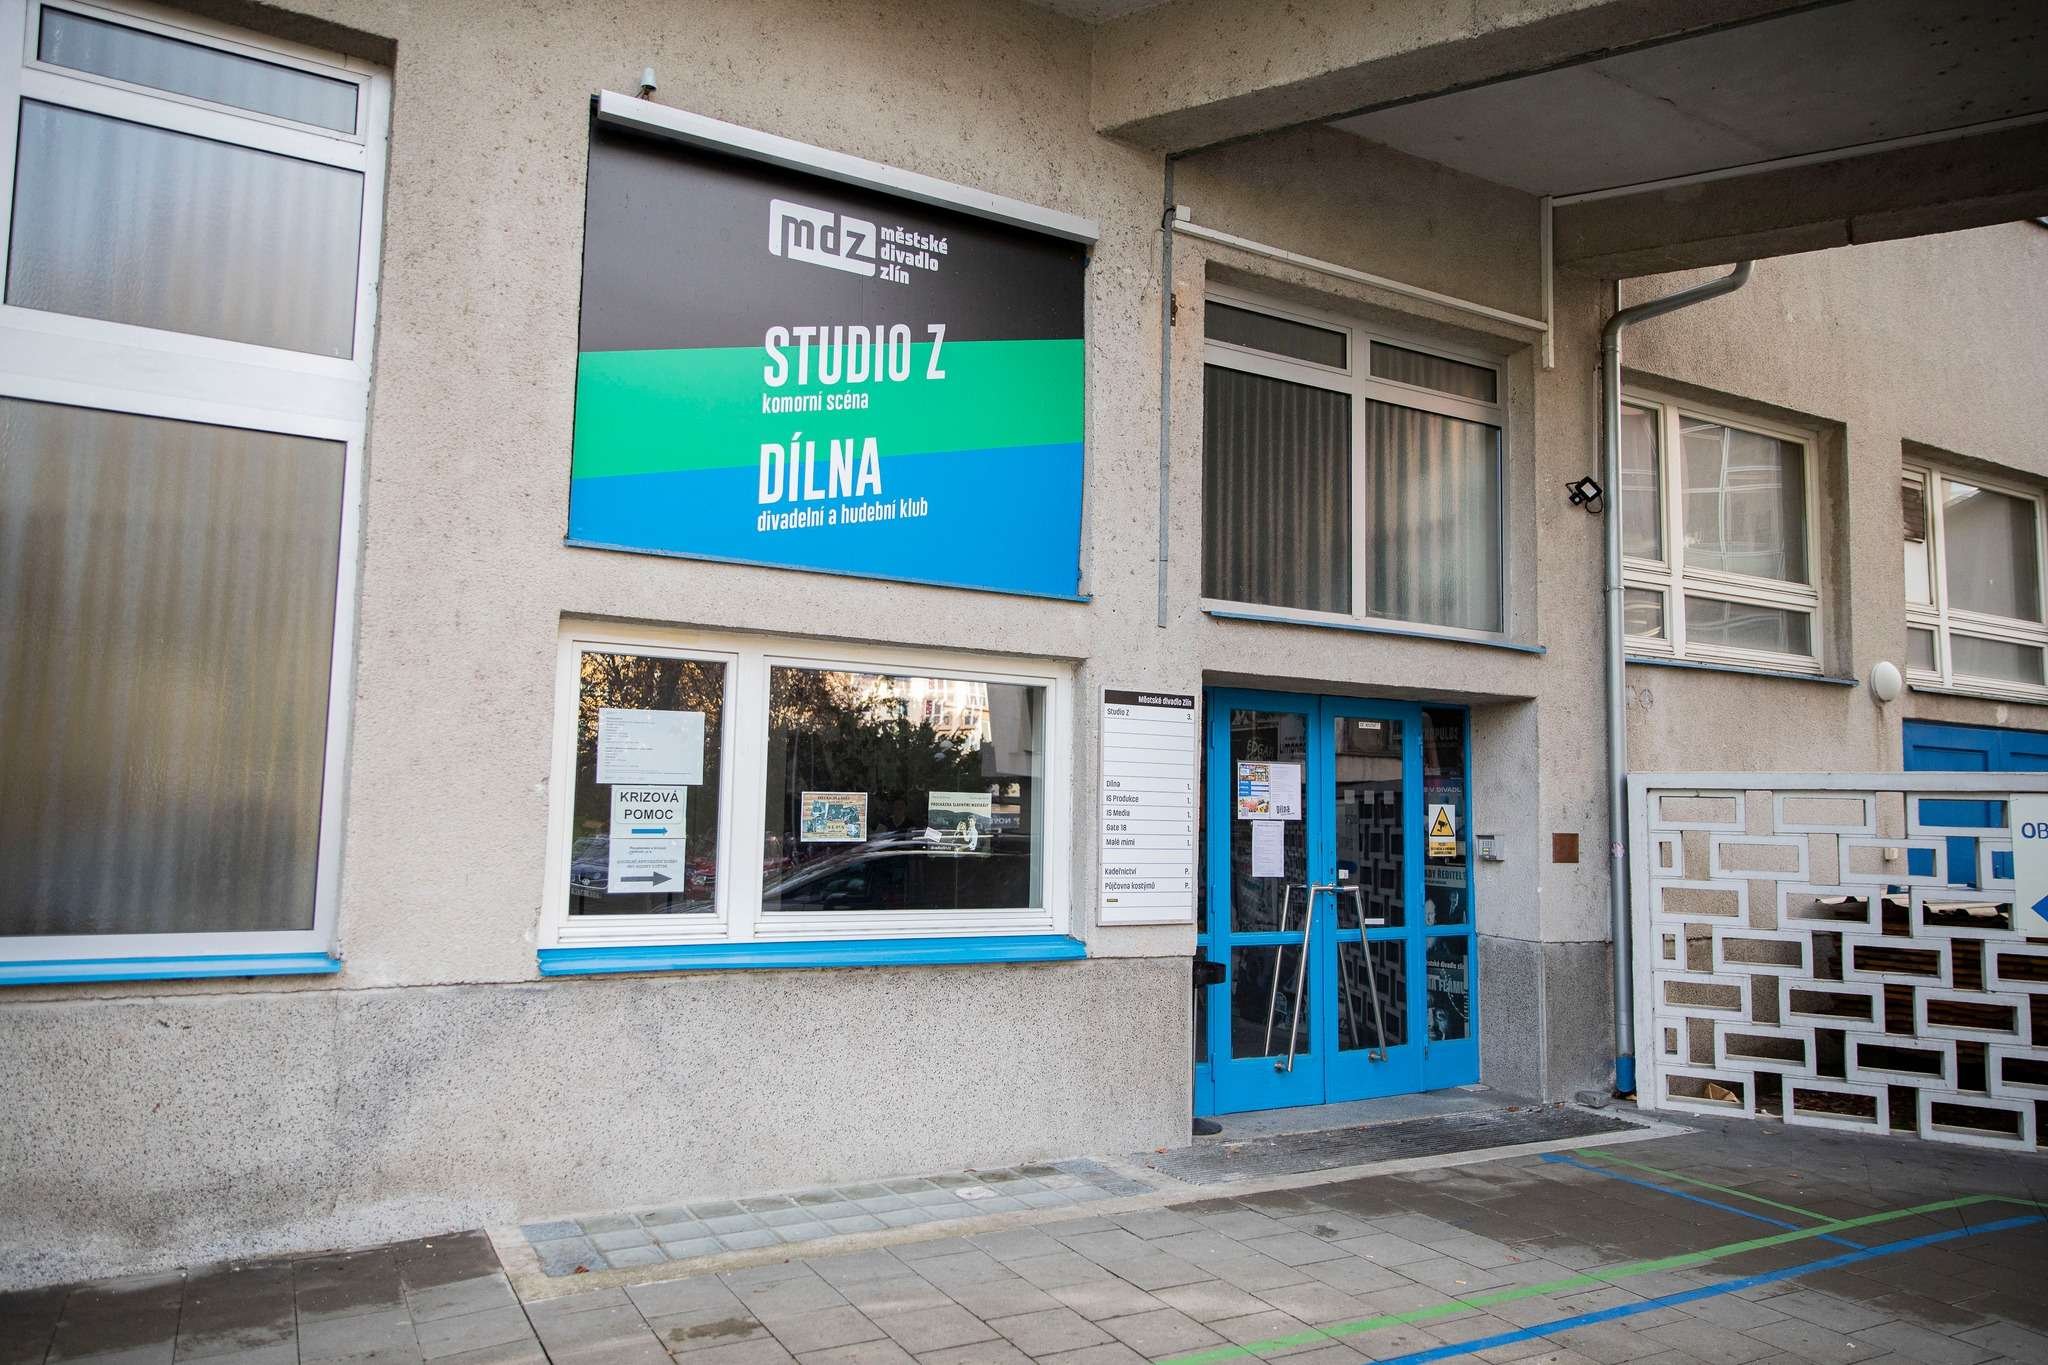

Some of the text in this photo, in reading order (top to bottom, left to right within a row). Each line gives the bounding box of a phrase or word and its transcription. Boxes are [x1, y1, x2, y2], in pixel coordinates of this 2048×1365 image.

[769, 199, 876, 277] mdz
[880, 226, 948, 255] městské
[880, 244, 939, 272] divadlo
[879, 264, 910, 285] zlín
[763, 323, 946, 387] STUDIO Z
[762, 389, 869, 414] komorní scéna
[758, 431, 882, 504] DÍLNA
[757, 497, 928, 532] divadelní a hudební klub
[1138, 695, 1161, 705] Městské
[1162, 697, 1182, 706] divadlo
[1106, 707, 1126, 716] Studio
[1106, 780, 1121, 788] Dílna
[620, 789, 679, 803] KRIZOVÁ
[1112, 794, 1139, 803] Produkce
[624, 809, 674, 820] POMOC
[1113, 808, 1131, 817] Media
[1104, 881, 1131, 891] Půjčovna
